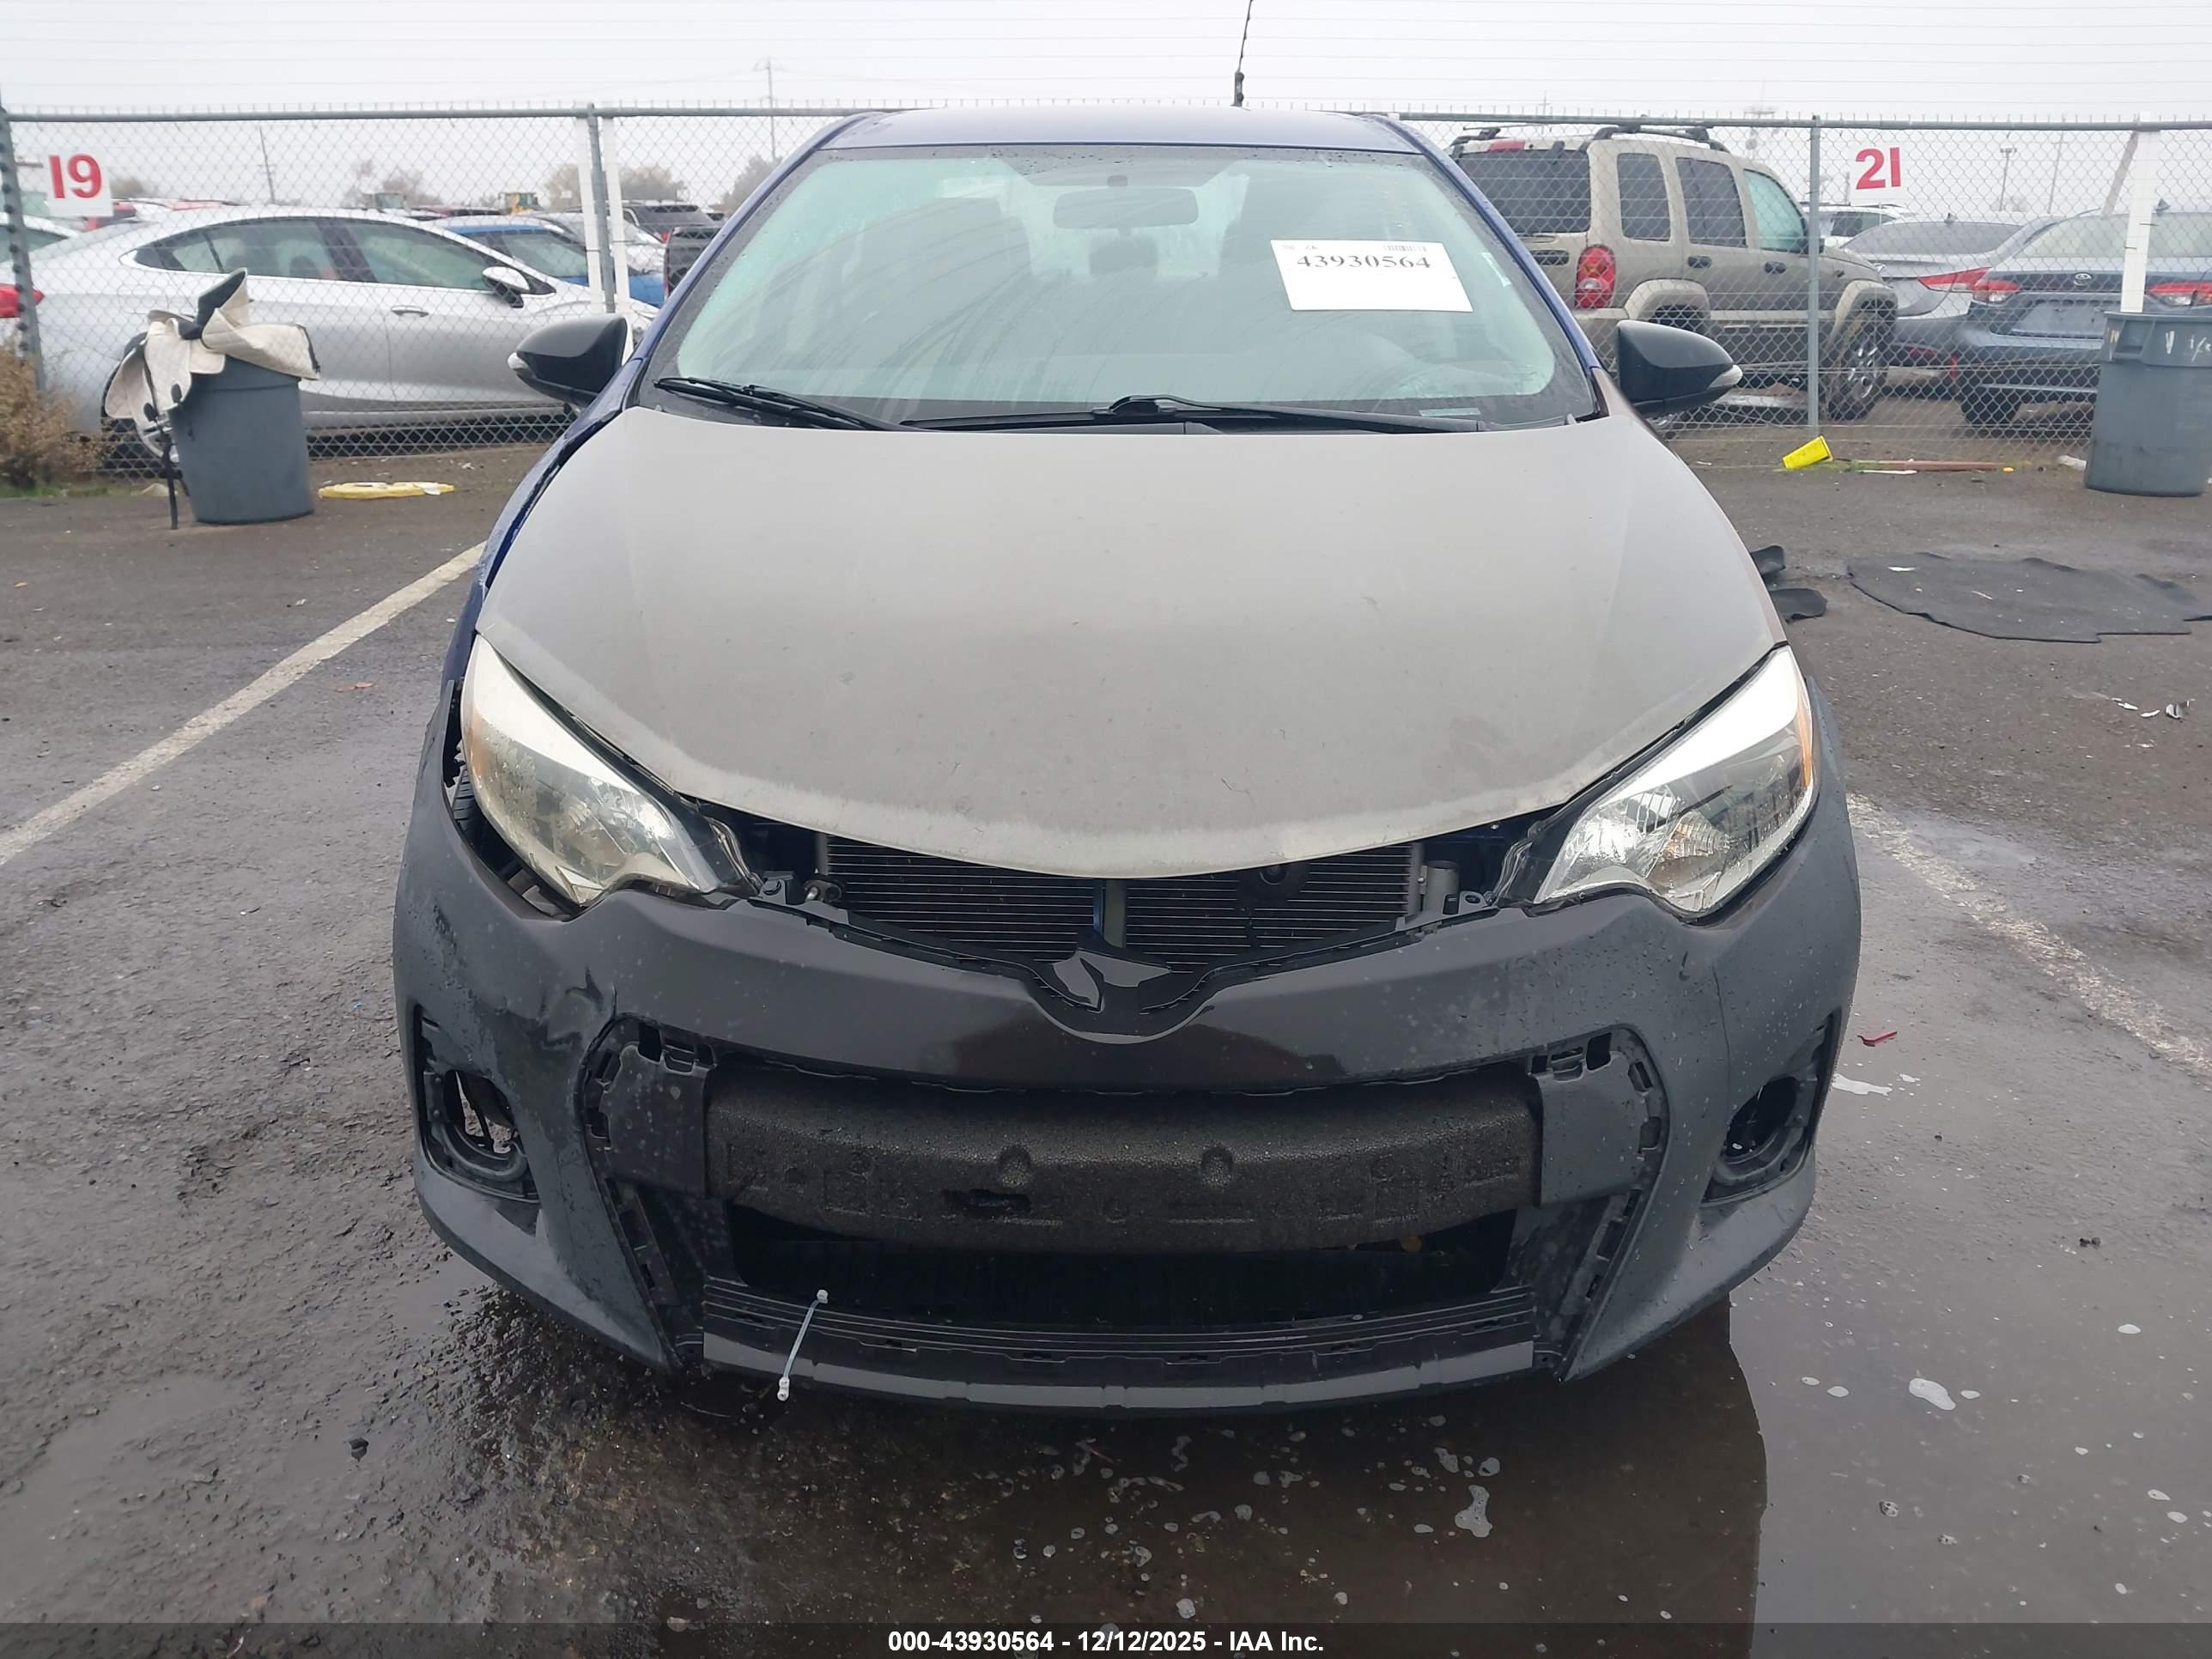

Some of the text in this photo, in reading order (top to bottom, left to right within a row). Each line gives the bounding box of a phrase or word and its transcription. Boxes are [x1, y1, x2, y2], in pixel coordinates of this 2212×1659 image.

[49, 153, 103, 199] 19
[1855, 147, 1902, 190] 21
[1297, 254, 1431, 269] 43930564
